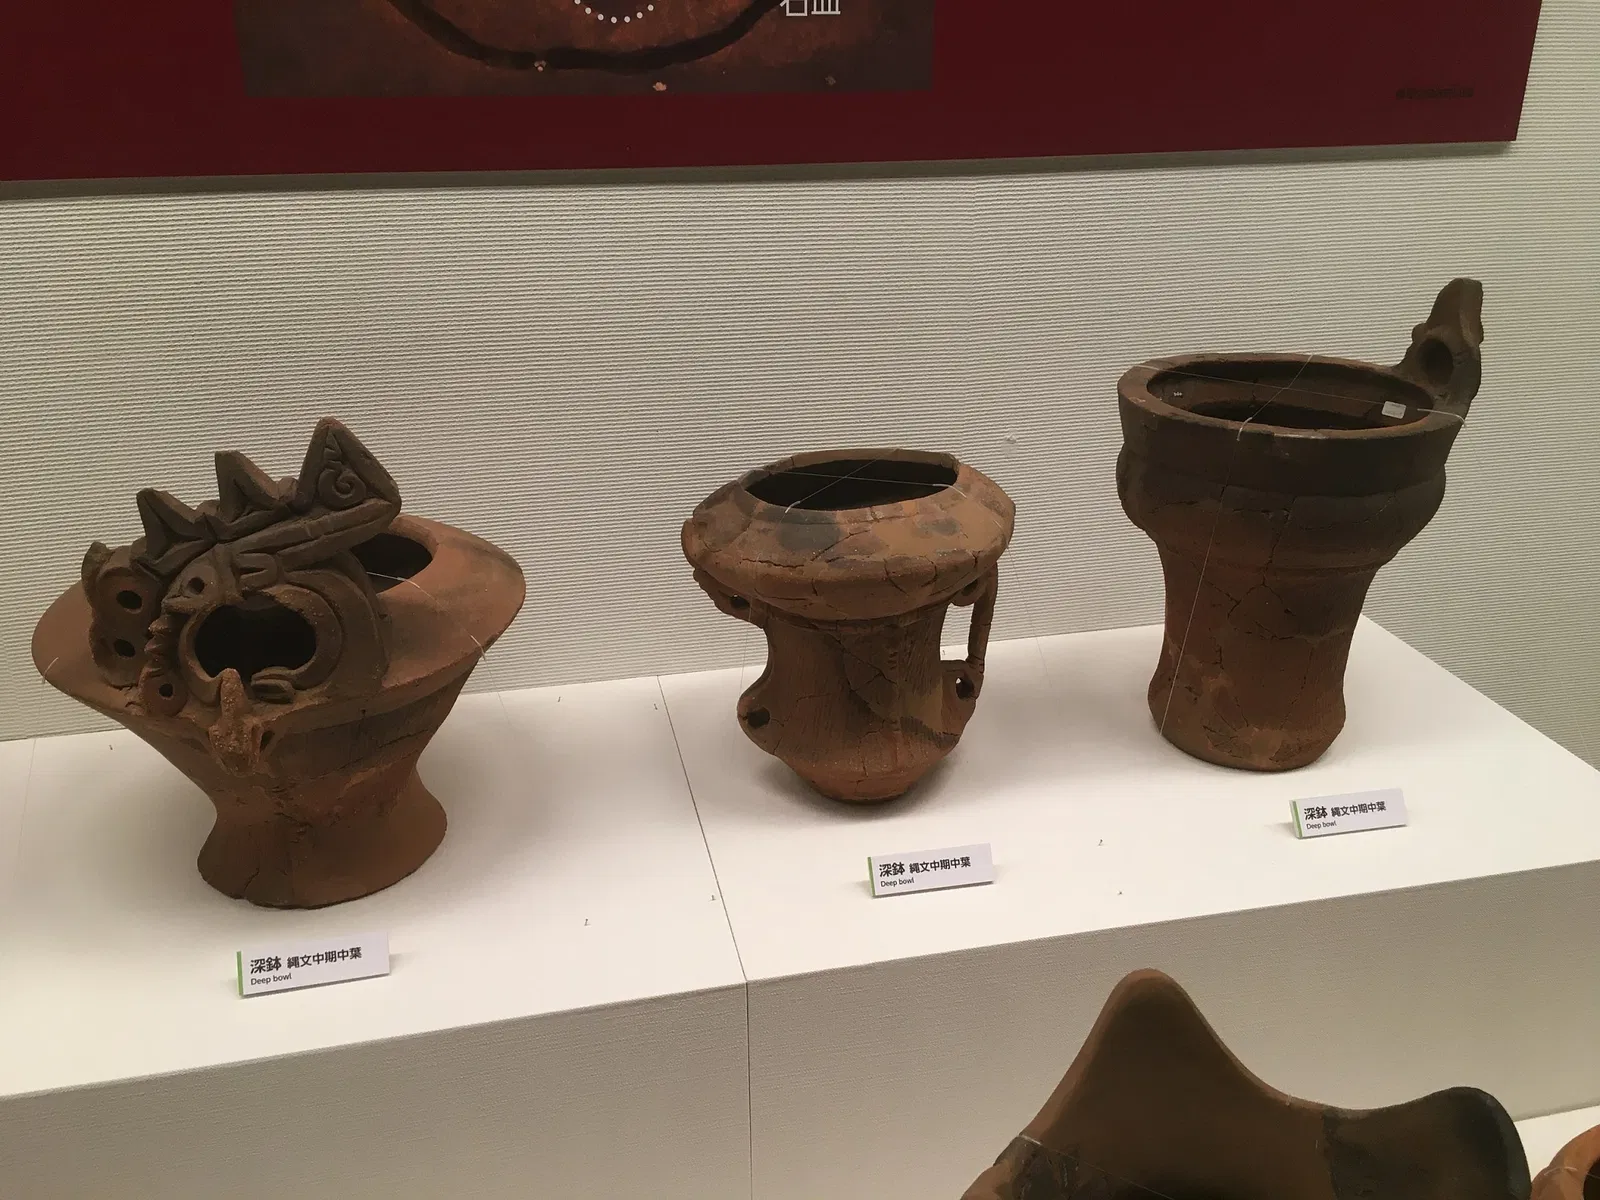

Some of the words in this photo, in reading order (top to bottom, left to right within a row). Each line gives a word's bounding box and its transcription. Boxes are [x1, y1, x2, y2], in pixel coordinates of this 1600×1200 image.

[1304, 806, 1328, 820] 深鉢
[1331, 801, 1386, 817] 縄文中期中葉
[1322, 820, 1337, 828] bowl
[879, 861, 905, 877] 深鉢
[909, 856, 971, 874] 縄文中期中葉
[898, 877, 915, 885] bowl
[250, 956, 281, 974] 深鉢
[287, 947, 362, 969] 縄文中期中葉
[250, 977, 271, 986] Deep
[273, 973, 292, 982] bowl
